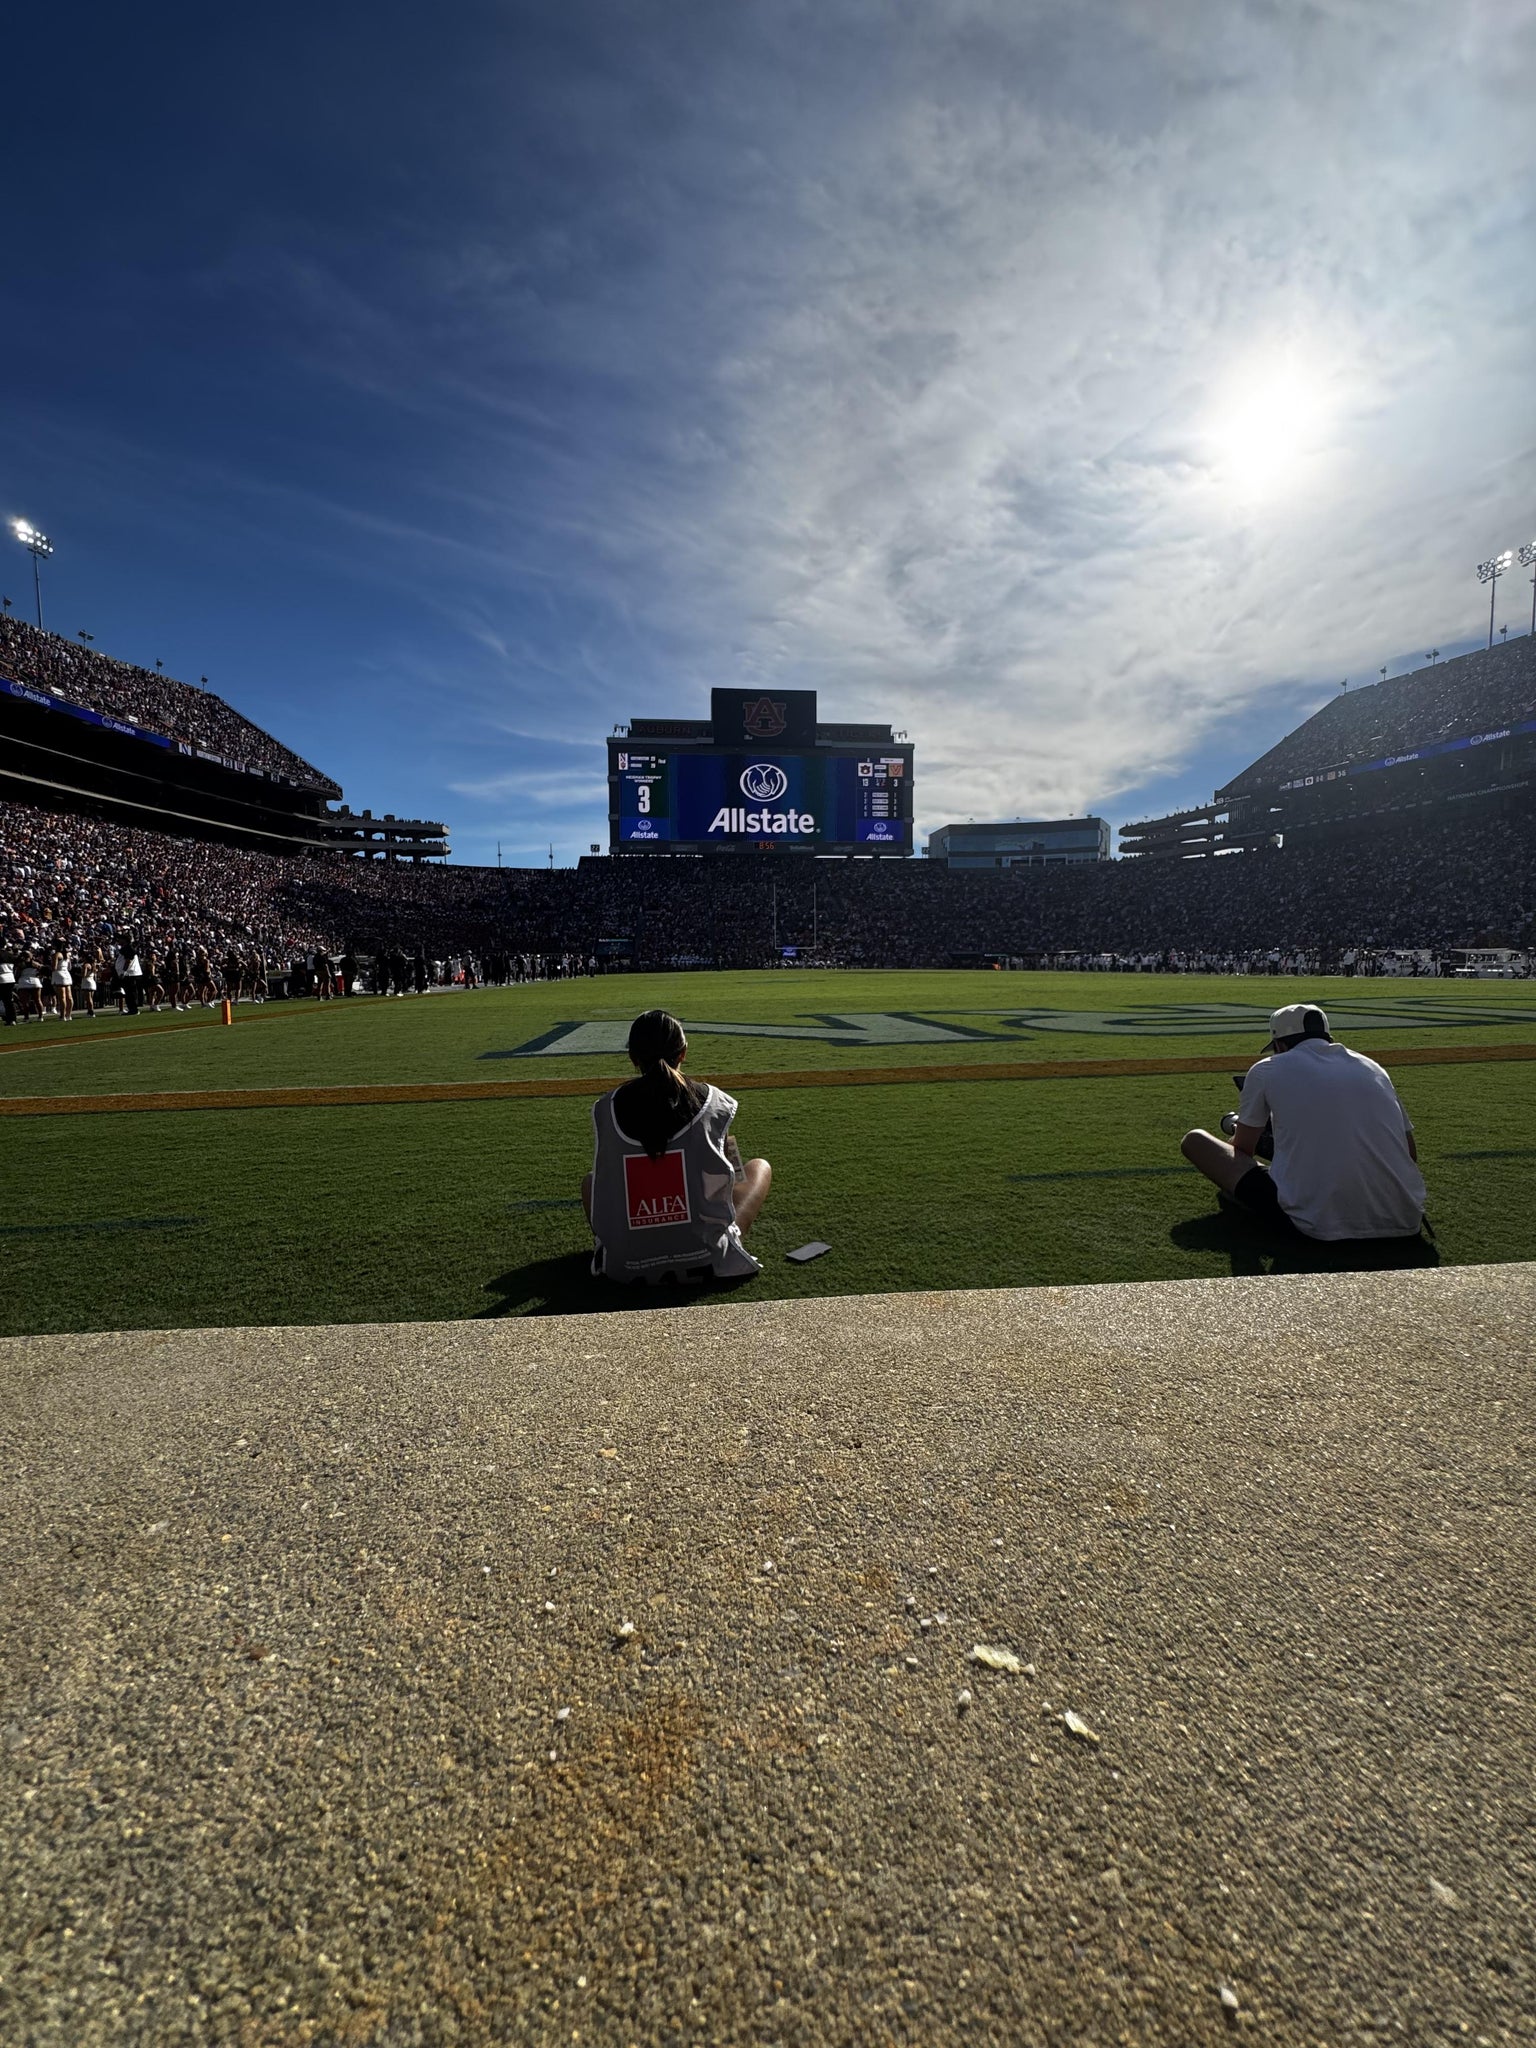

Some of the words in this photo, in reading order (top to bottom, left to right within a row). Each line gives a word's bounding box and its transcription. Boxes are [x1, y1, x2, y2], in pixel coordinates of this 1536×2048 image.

[23, 689, 52, 707] Allstate
[112, 720, 136, 736] Allstate
[1482, 729, 1511, 743] Allstate
[1394, 752, 1419, 764] Allstate
[638, 785, 651, 814] 3
[707, 807, 815, 833] Allstate
[630, 831, 659, 839] Allstate
[866, 833, 894, 841] Allstate
[636, 1194, 686, 1216] ALFA
[632, 1214, 686, 1226] INSURANCE
